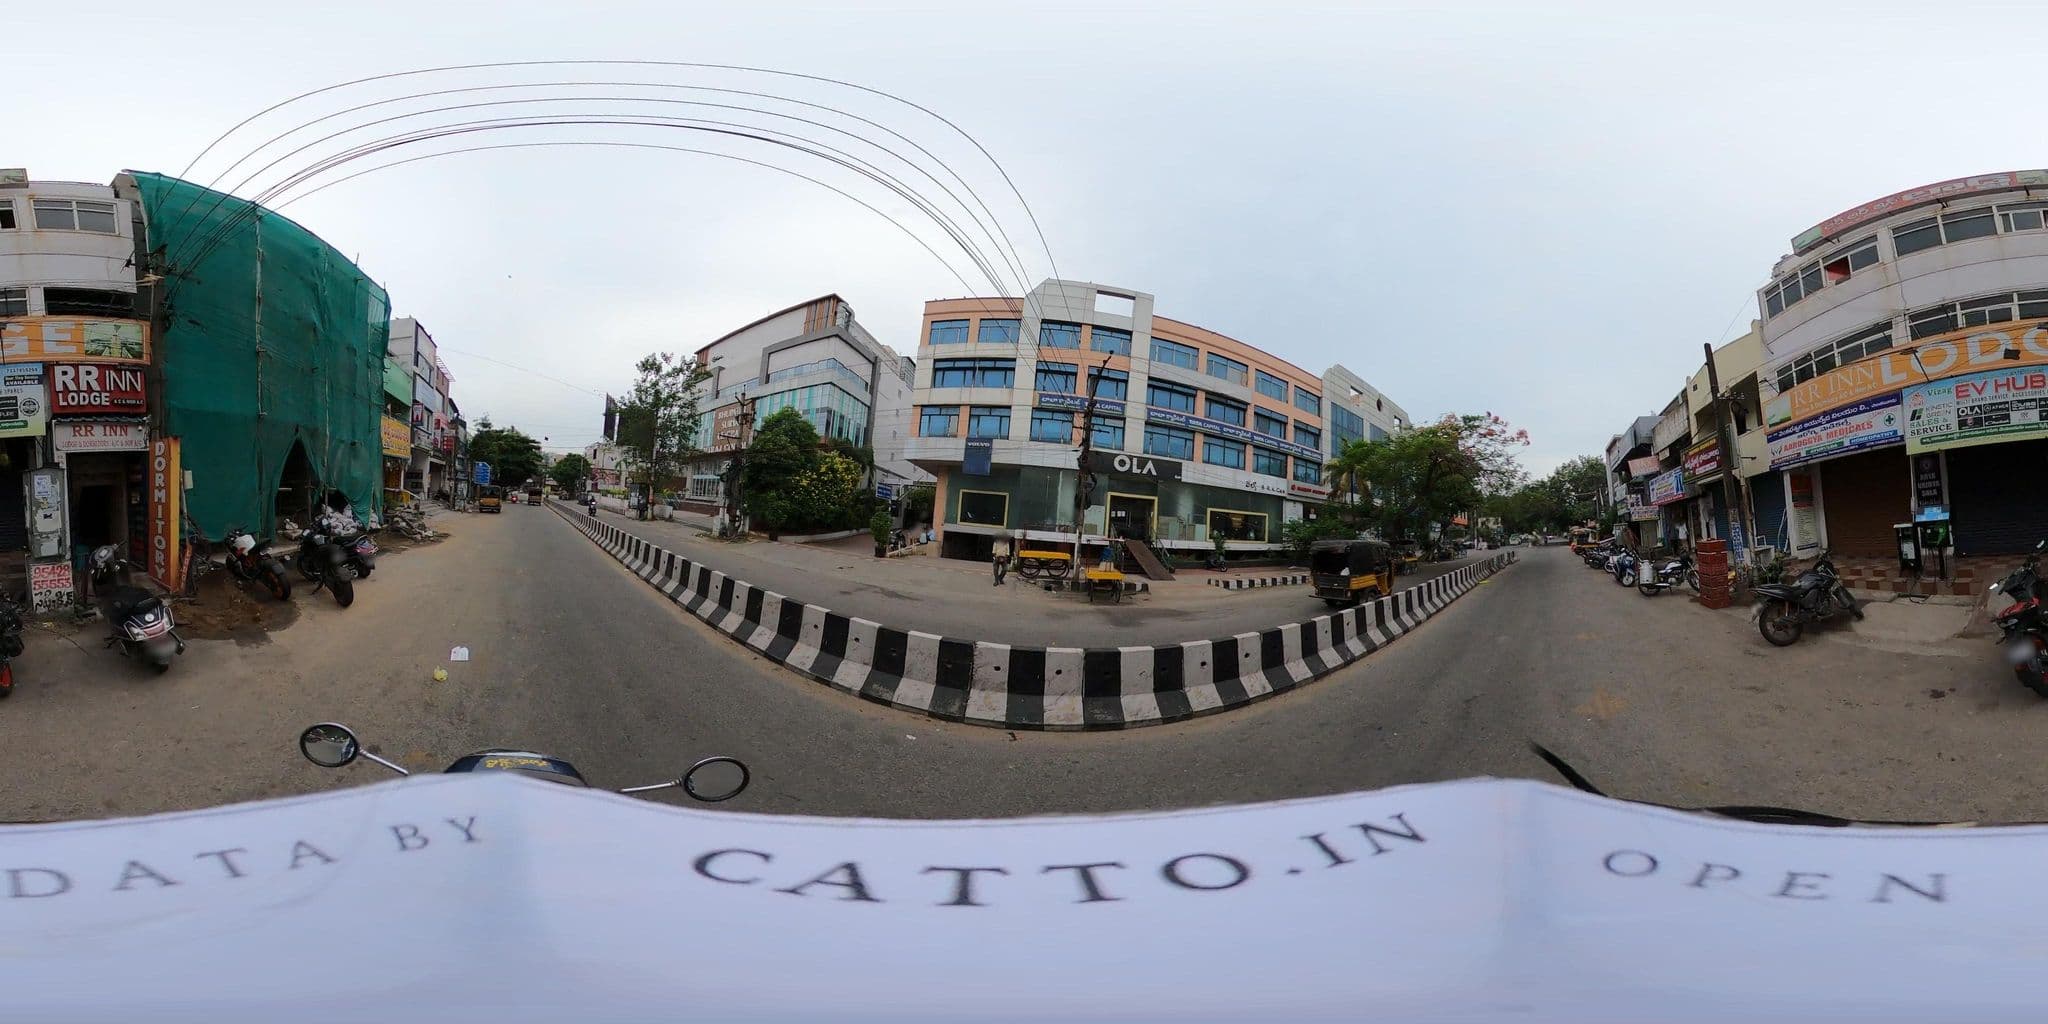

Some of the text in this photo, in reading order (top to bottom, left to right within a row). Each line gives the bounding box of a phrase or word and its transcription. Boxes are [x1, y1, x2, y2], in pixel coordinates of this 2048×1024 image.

[54, 365, 141, 392] RR INN
[1829, 362, 1876, 394] INN
[1927, 387, 1952, 397] Vizag
[1955, 379, 1988, 399] EV
[1994, 373, 2047, 393] HUB
[58, 392, 110, 406] LODGE
[1100, 403, 1122, 411] CAPITAL
[1958, 406, 1981, 416] OLA
[1203, 422, 1221, 431] CAPITAL
[1910, 418, 1940, 428] SALES
[1910, 423, 1953, 437] SERVICE
[71, 424, 129, 437] RR INN
[1850, 430, 1895, 443] HOMEOPATHY
[1113, 454, 1157, 476] OLA
[154, 441, 167, 579] DORMITORY
[4, 811, 1950, 906] DATA BY CATTO.IN OPEN
